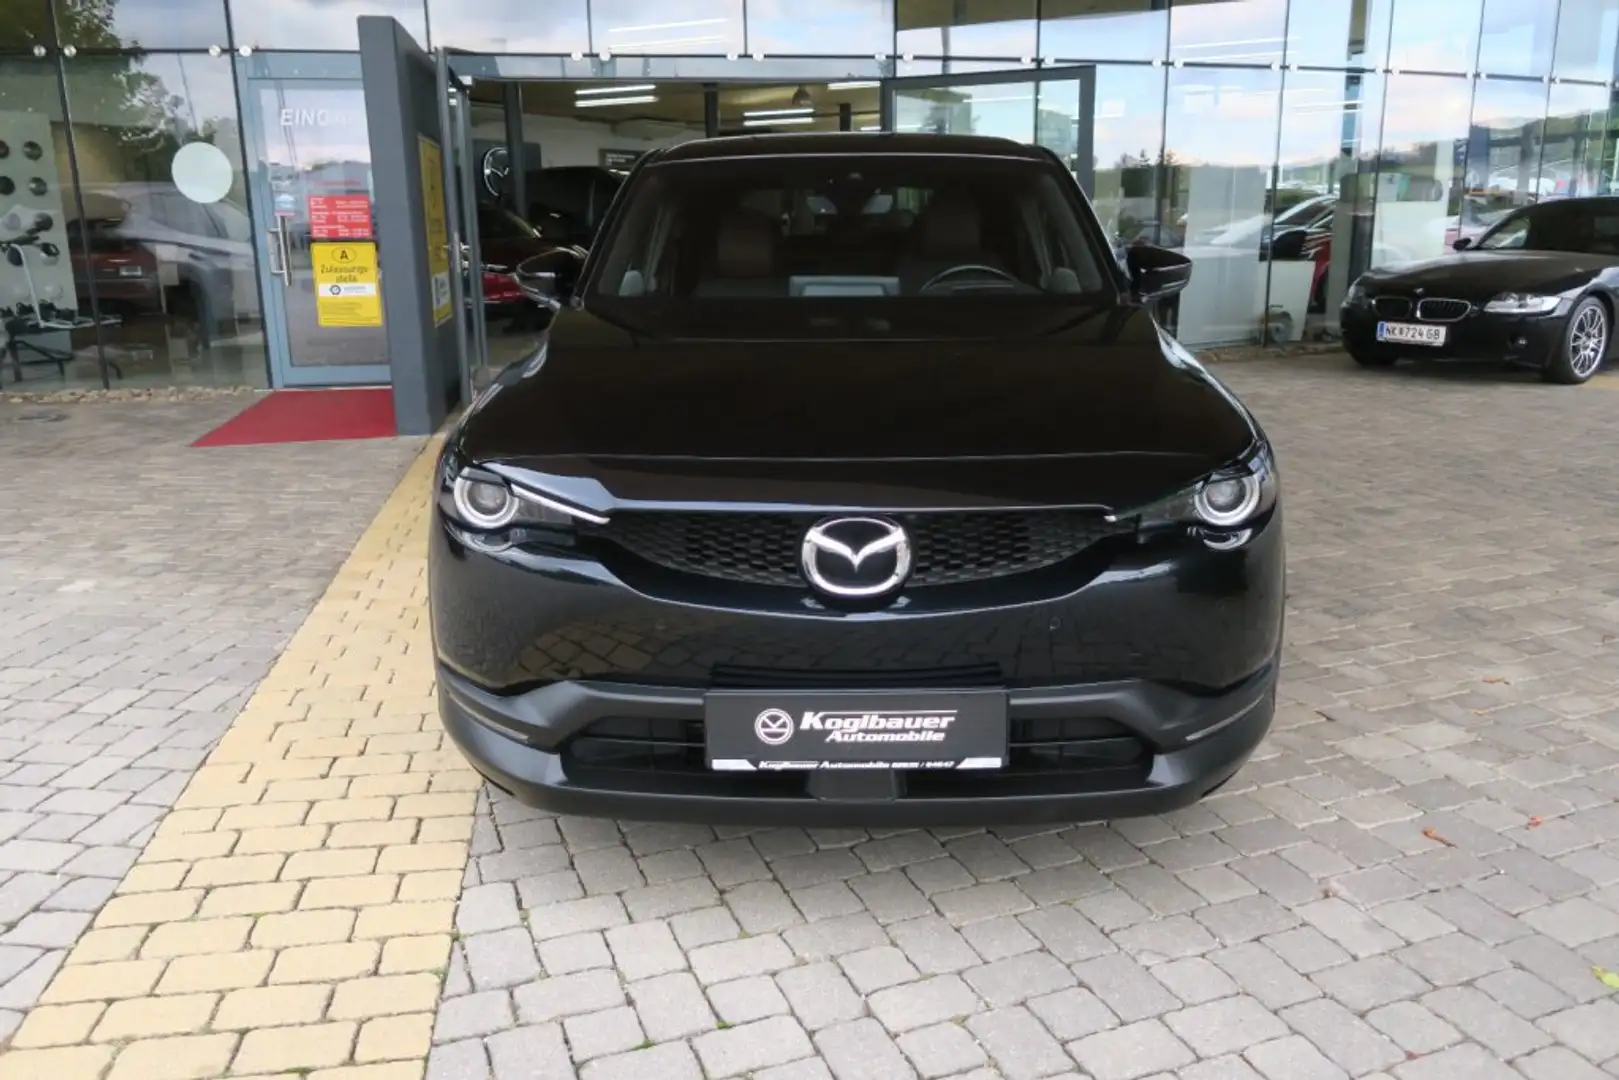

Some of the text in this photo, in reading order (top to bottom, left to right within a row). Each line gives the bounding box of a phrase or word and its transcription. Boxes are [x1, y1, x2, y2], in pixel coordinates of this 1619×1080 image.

[340, 249, 349, 260] A
[800, 710, 957, 733] Koglbauer
[825, 730, 945, 743] Automobile
